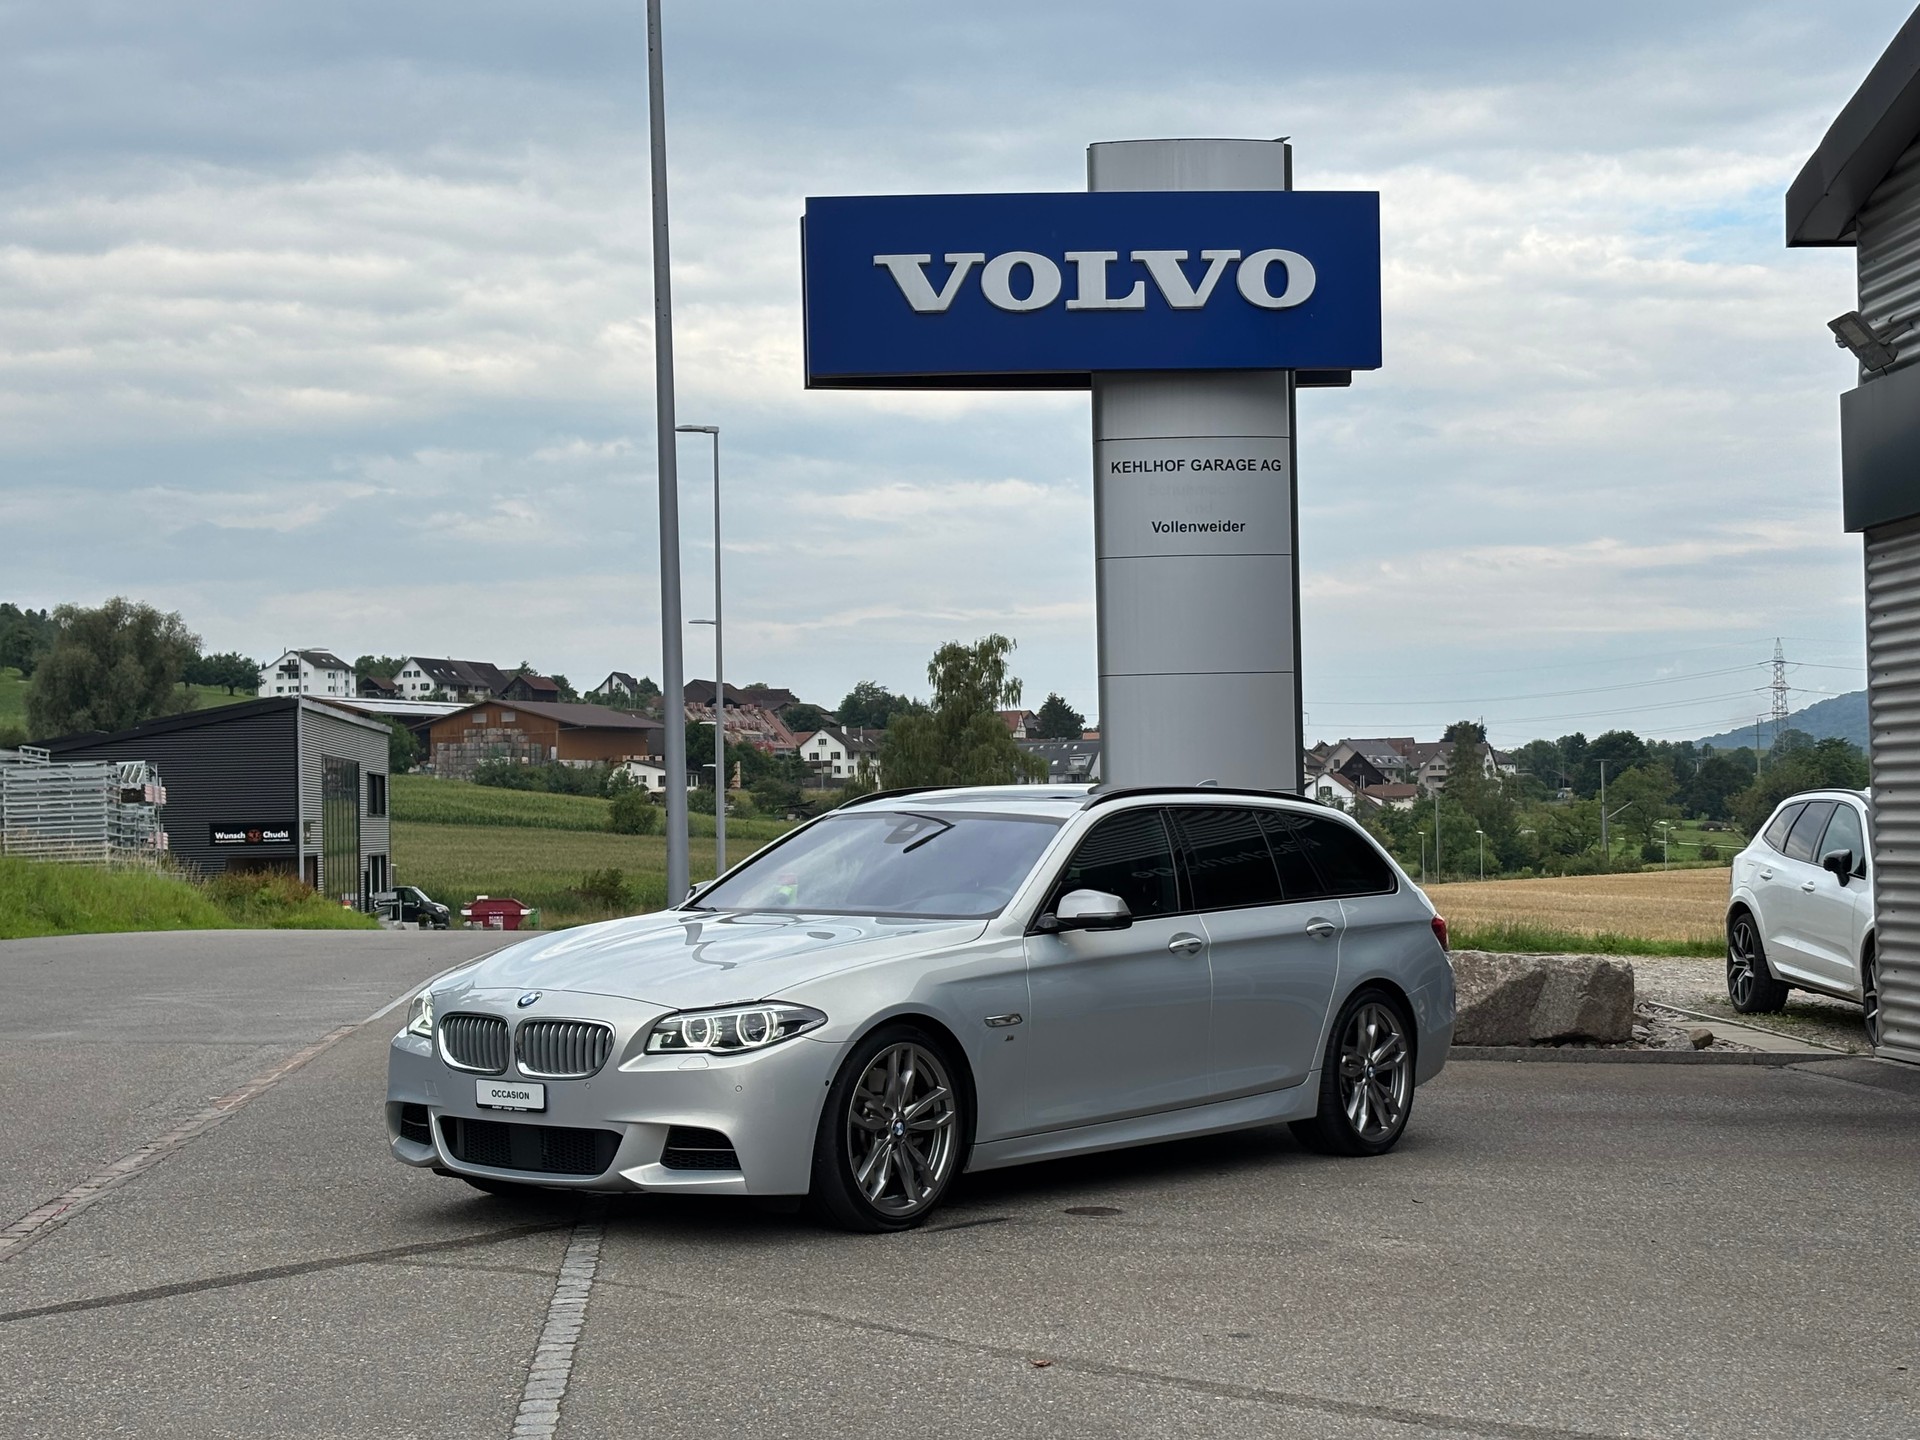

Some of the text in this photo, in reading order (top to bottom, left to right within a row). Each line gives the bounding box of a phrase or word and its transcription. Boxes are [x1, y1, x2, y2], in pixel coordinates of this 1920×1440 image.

[873, 249, 1317, 313] VOLVO
[1111, 459, 1282, 473] KEHLHOF GARAGE AG
[1151, 520, 1246, 533] Vollenweider
[215, 830, 289, 839] Wunsch Chuchi
[491, 1089, 530, 1100] OCCASION
